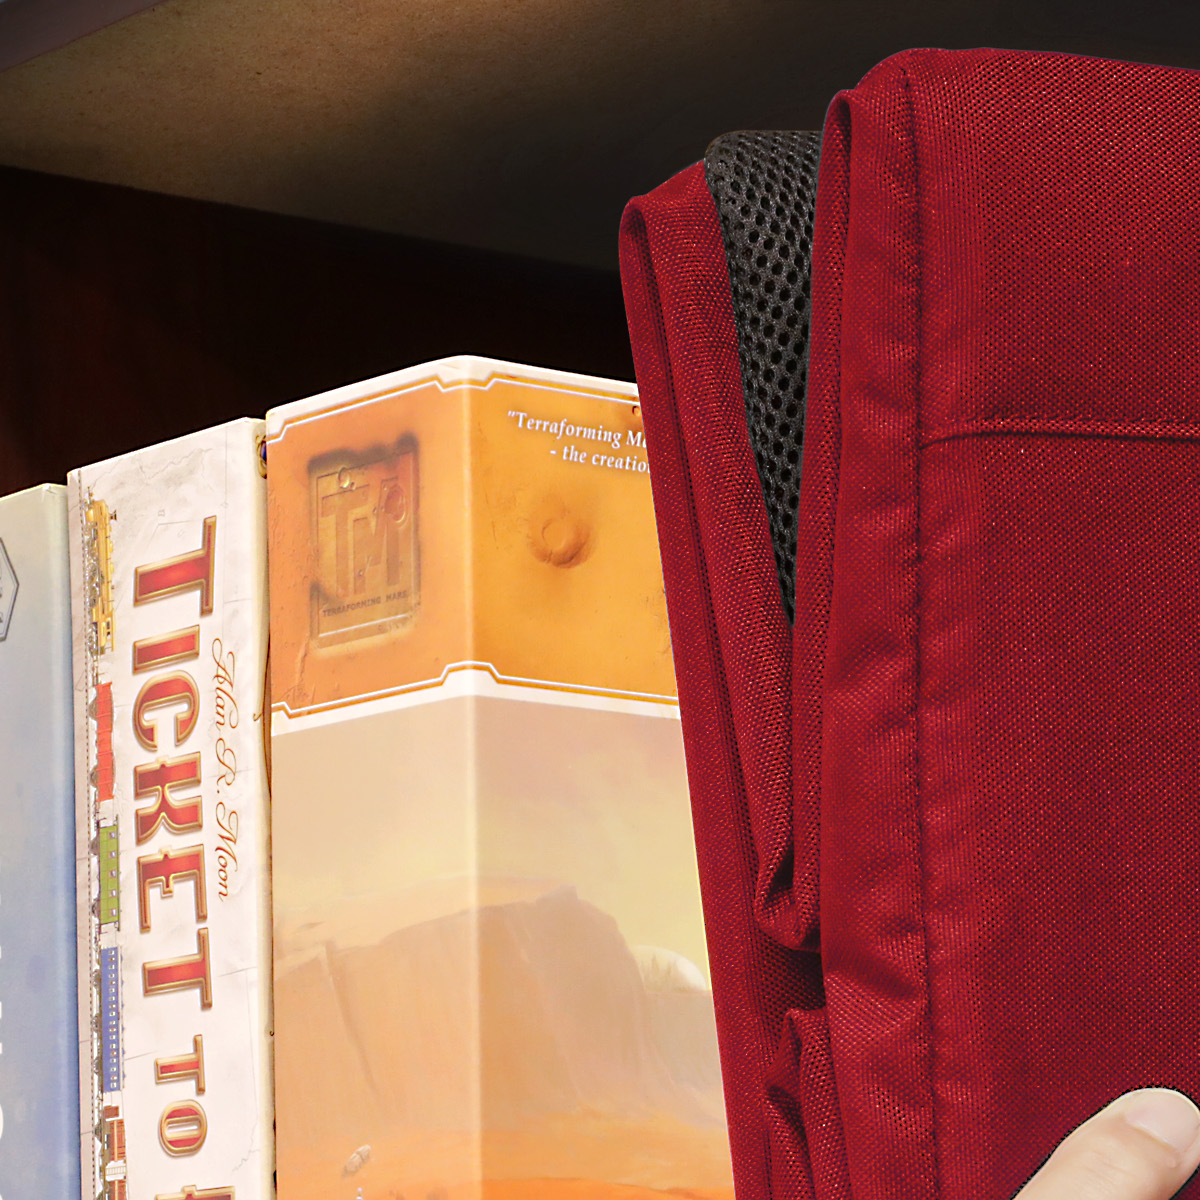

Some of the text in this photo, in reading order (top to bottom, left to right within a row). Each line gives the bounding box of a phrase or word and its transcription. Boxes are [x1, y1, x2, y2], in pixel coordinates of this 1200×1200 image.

[562, 445, 587, 463] the
[592, 454, 651, 474] creatio
[322, 590, 409, 617] TERRAFORMING MARS
[212, 638, 239, 730] Alan
[132, 515, 217, 1011] TICKET
[214, 801, 239, 901] Moon
[155, 1034, 208, 1158] TO
